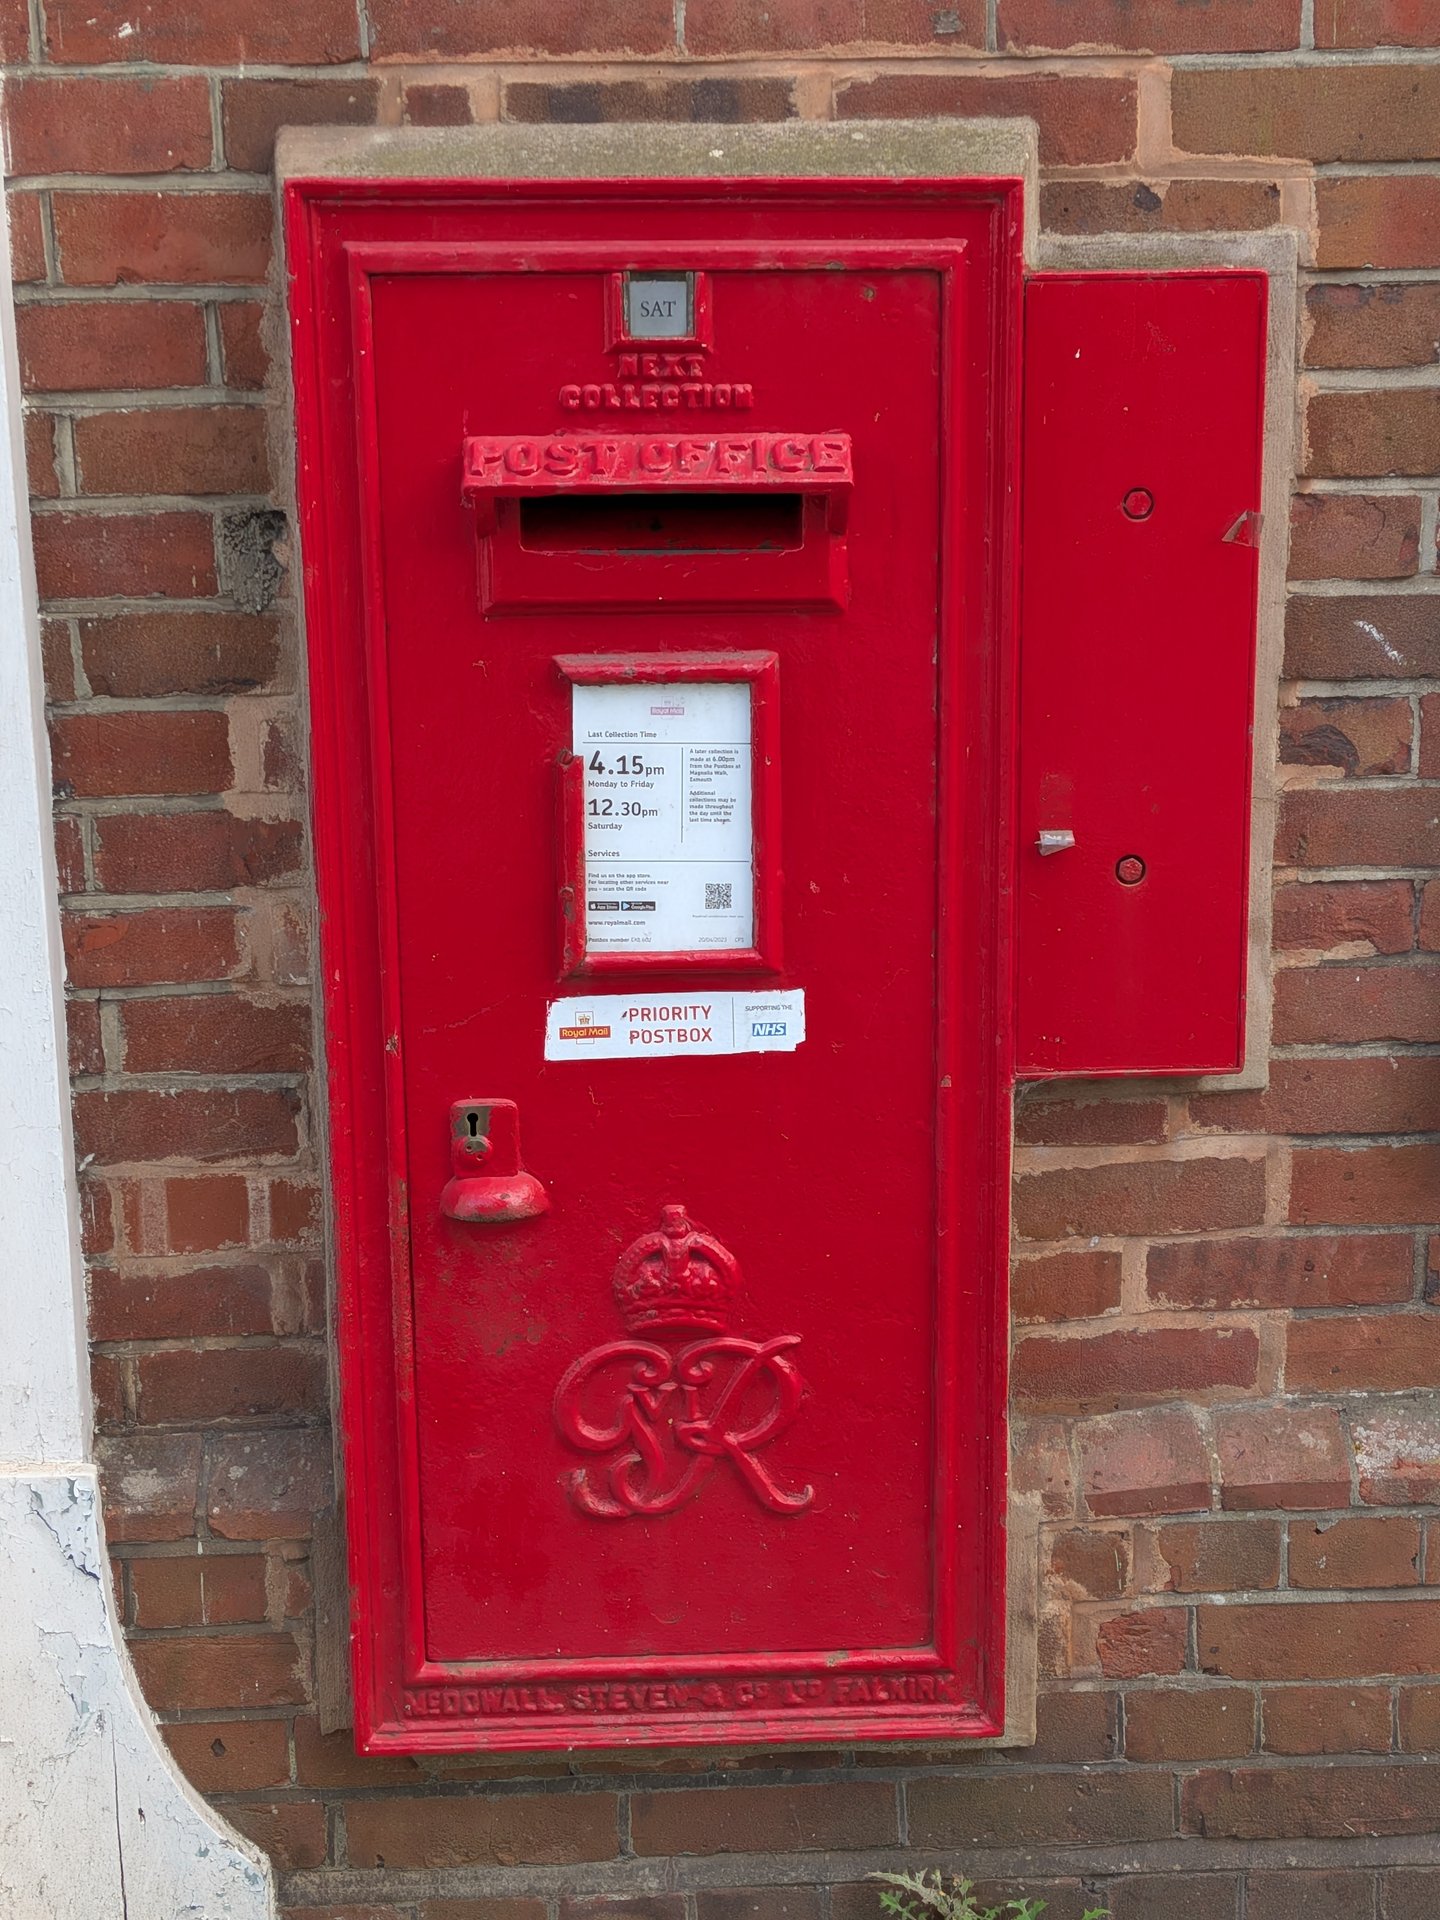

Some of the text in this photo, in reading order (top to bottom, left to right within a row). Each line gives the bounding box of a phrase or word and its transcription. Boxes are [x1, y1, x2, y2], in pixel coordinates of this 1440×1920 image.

[640, 300, 677, 318] SAT
[617, 353, 706, 378] NEXT
[558, 383, 755, 411] COLLECTION
[469, 436, 852, 477] POST OFFICE
[588, 750, 665, 778] 4.15pm
[588, 780, 655, 790] Monday to Friday
[588, 798, 658, 818] 12.30pm
[588, 822, 623, 831] Saturday
[588, 849, 620, 857] Services
[629, 1005, 713, 1022] PRIORITY
[745, 1004, 781, 1012] SUPPORTING
[561, 1027, 609, 1039] Royal Mail
[629, 1027, 713, 1044] POSTBOX
[753, 1023, 785, 1036] NHS
[572, 1682, 690, 1712] STEVEN
[832, 1673, 956, 1703] FALKIRK
